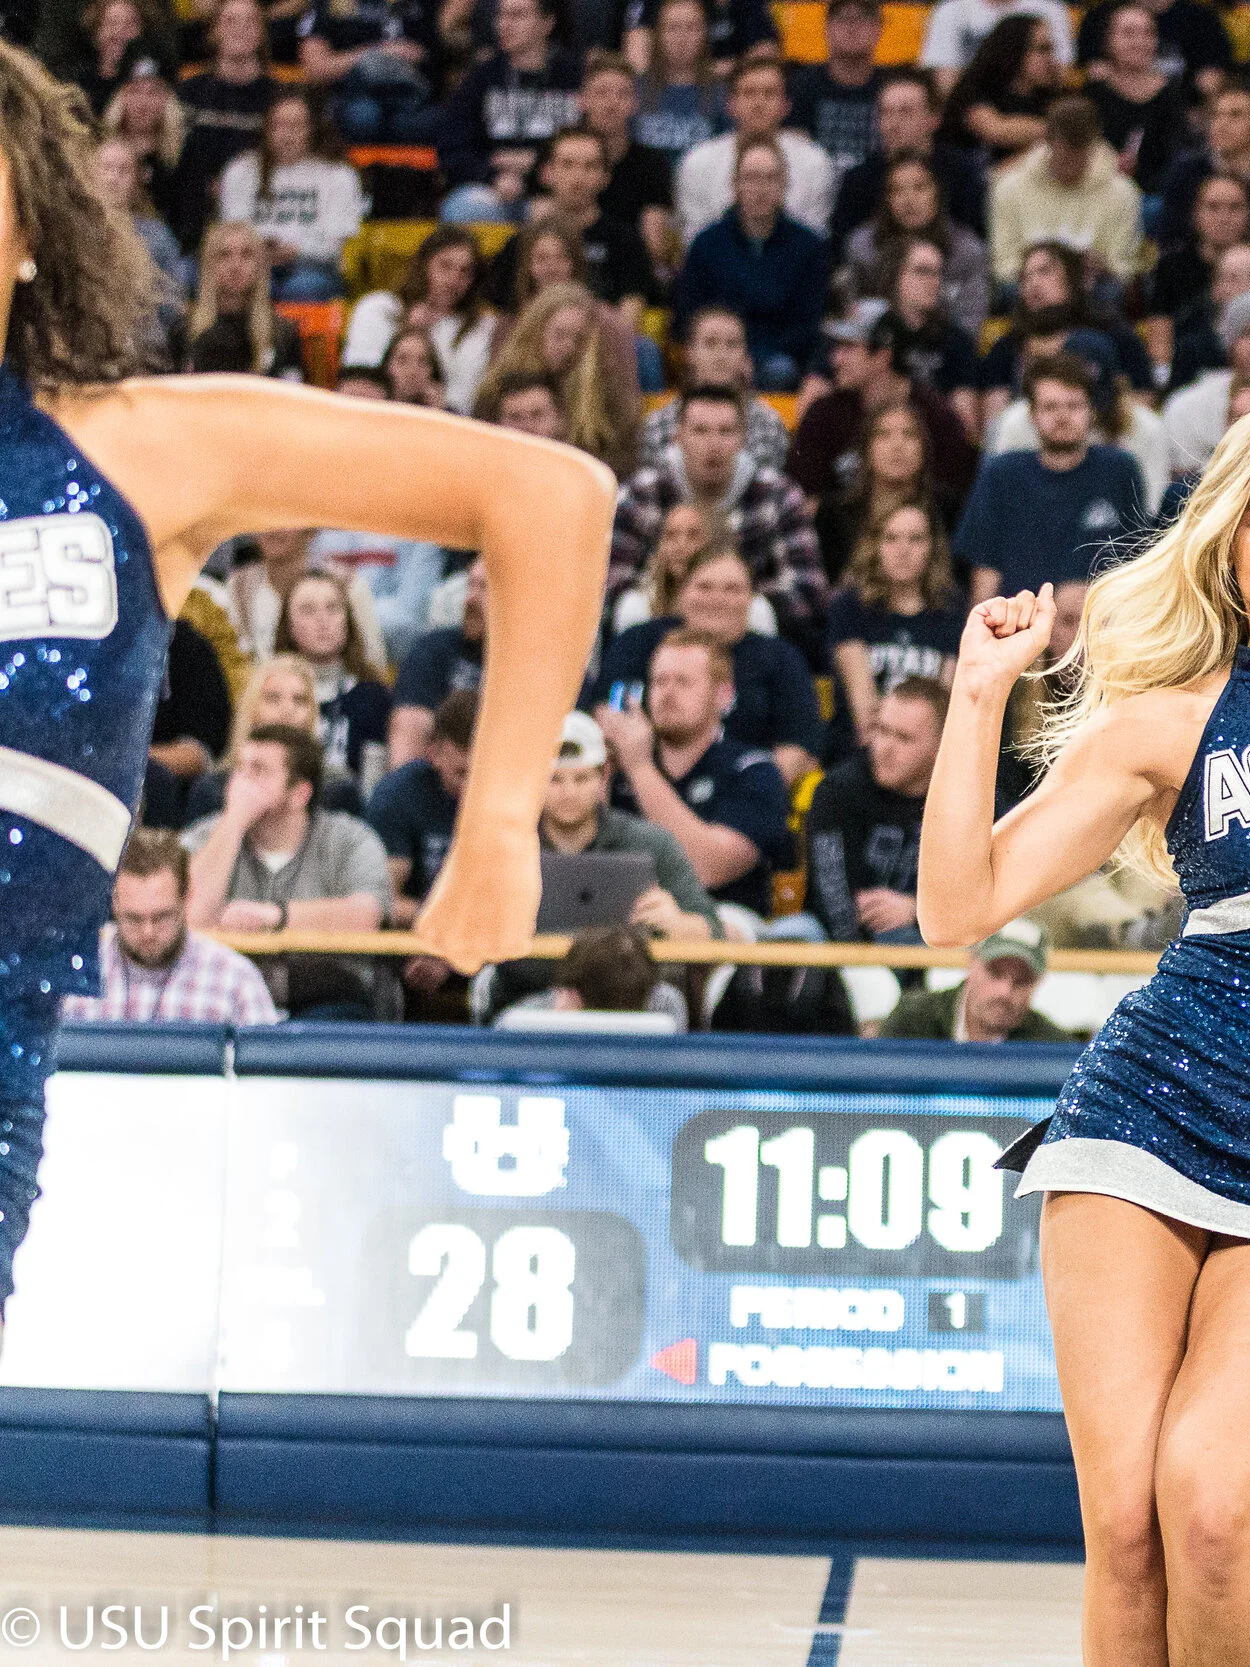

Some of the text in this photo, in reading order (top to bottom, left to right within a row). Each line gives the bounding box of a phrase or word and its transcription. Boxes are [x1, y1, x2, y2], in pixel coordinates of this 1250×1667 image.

[705, 1125, 1003, 1252] 11:09
[405, 1223, 576, 1361] 28
[945, 1292, 965, 1328] 1
